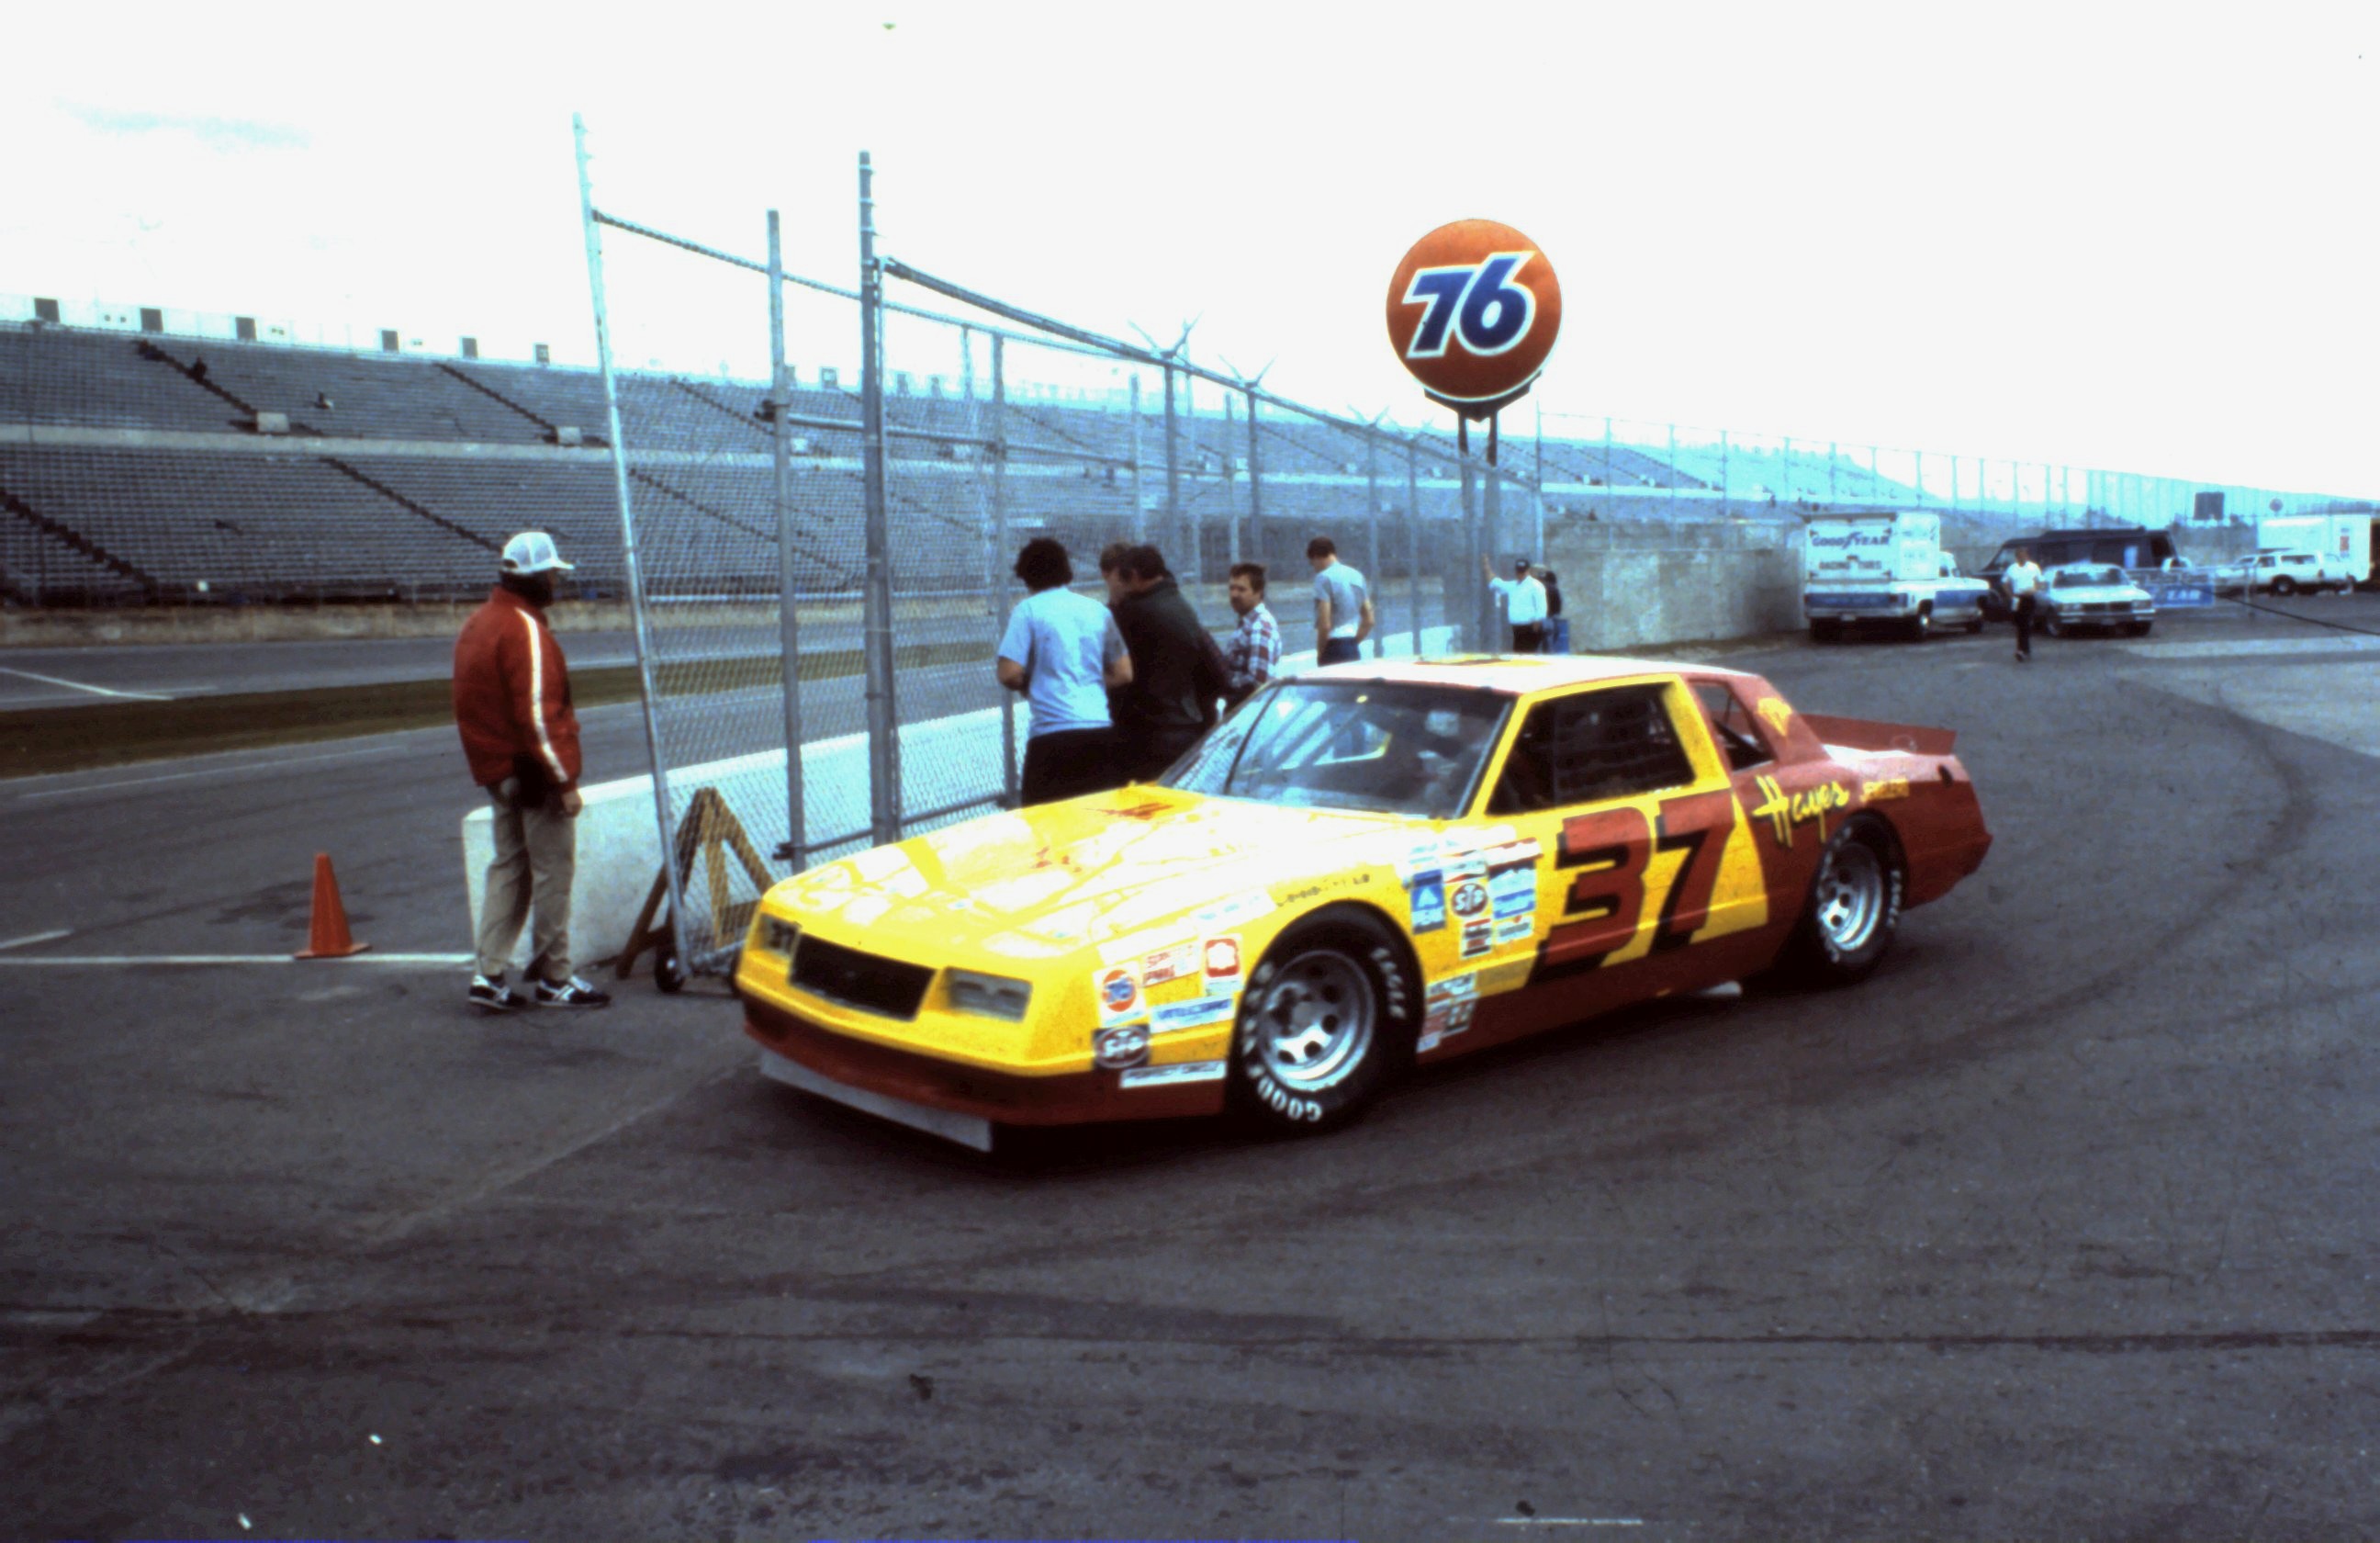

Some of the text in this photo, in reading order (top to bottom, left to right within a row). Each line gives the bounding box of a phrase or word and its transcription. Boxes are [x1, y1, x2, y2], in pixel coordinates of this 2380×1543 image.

[1403, 250, 1536, 358] 76
[1752, 775, 1850, 849] Hayes
[1539, 787, 1734, 977] 37
